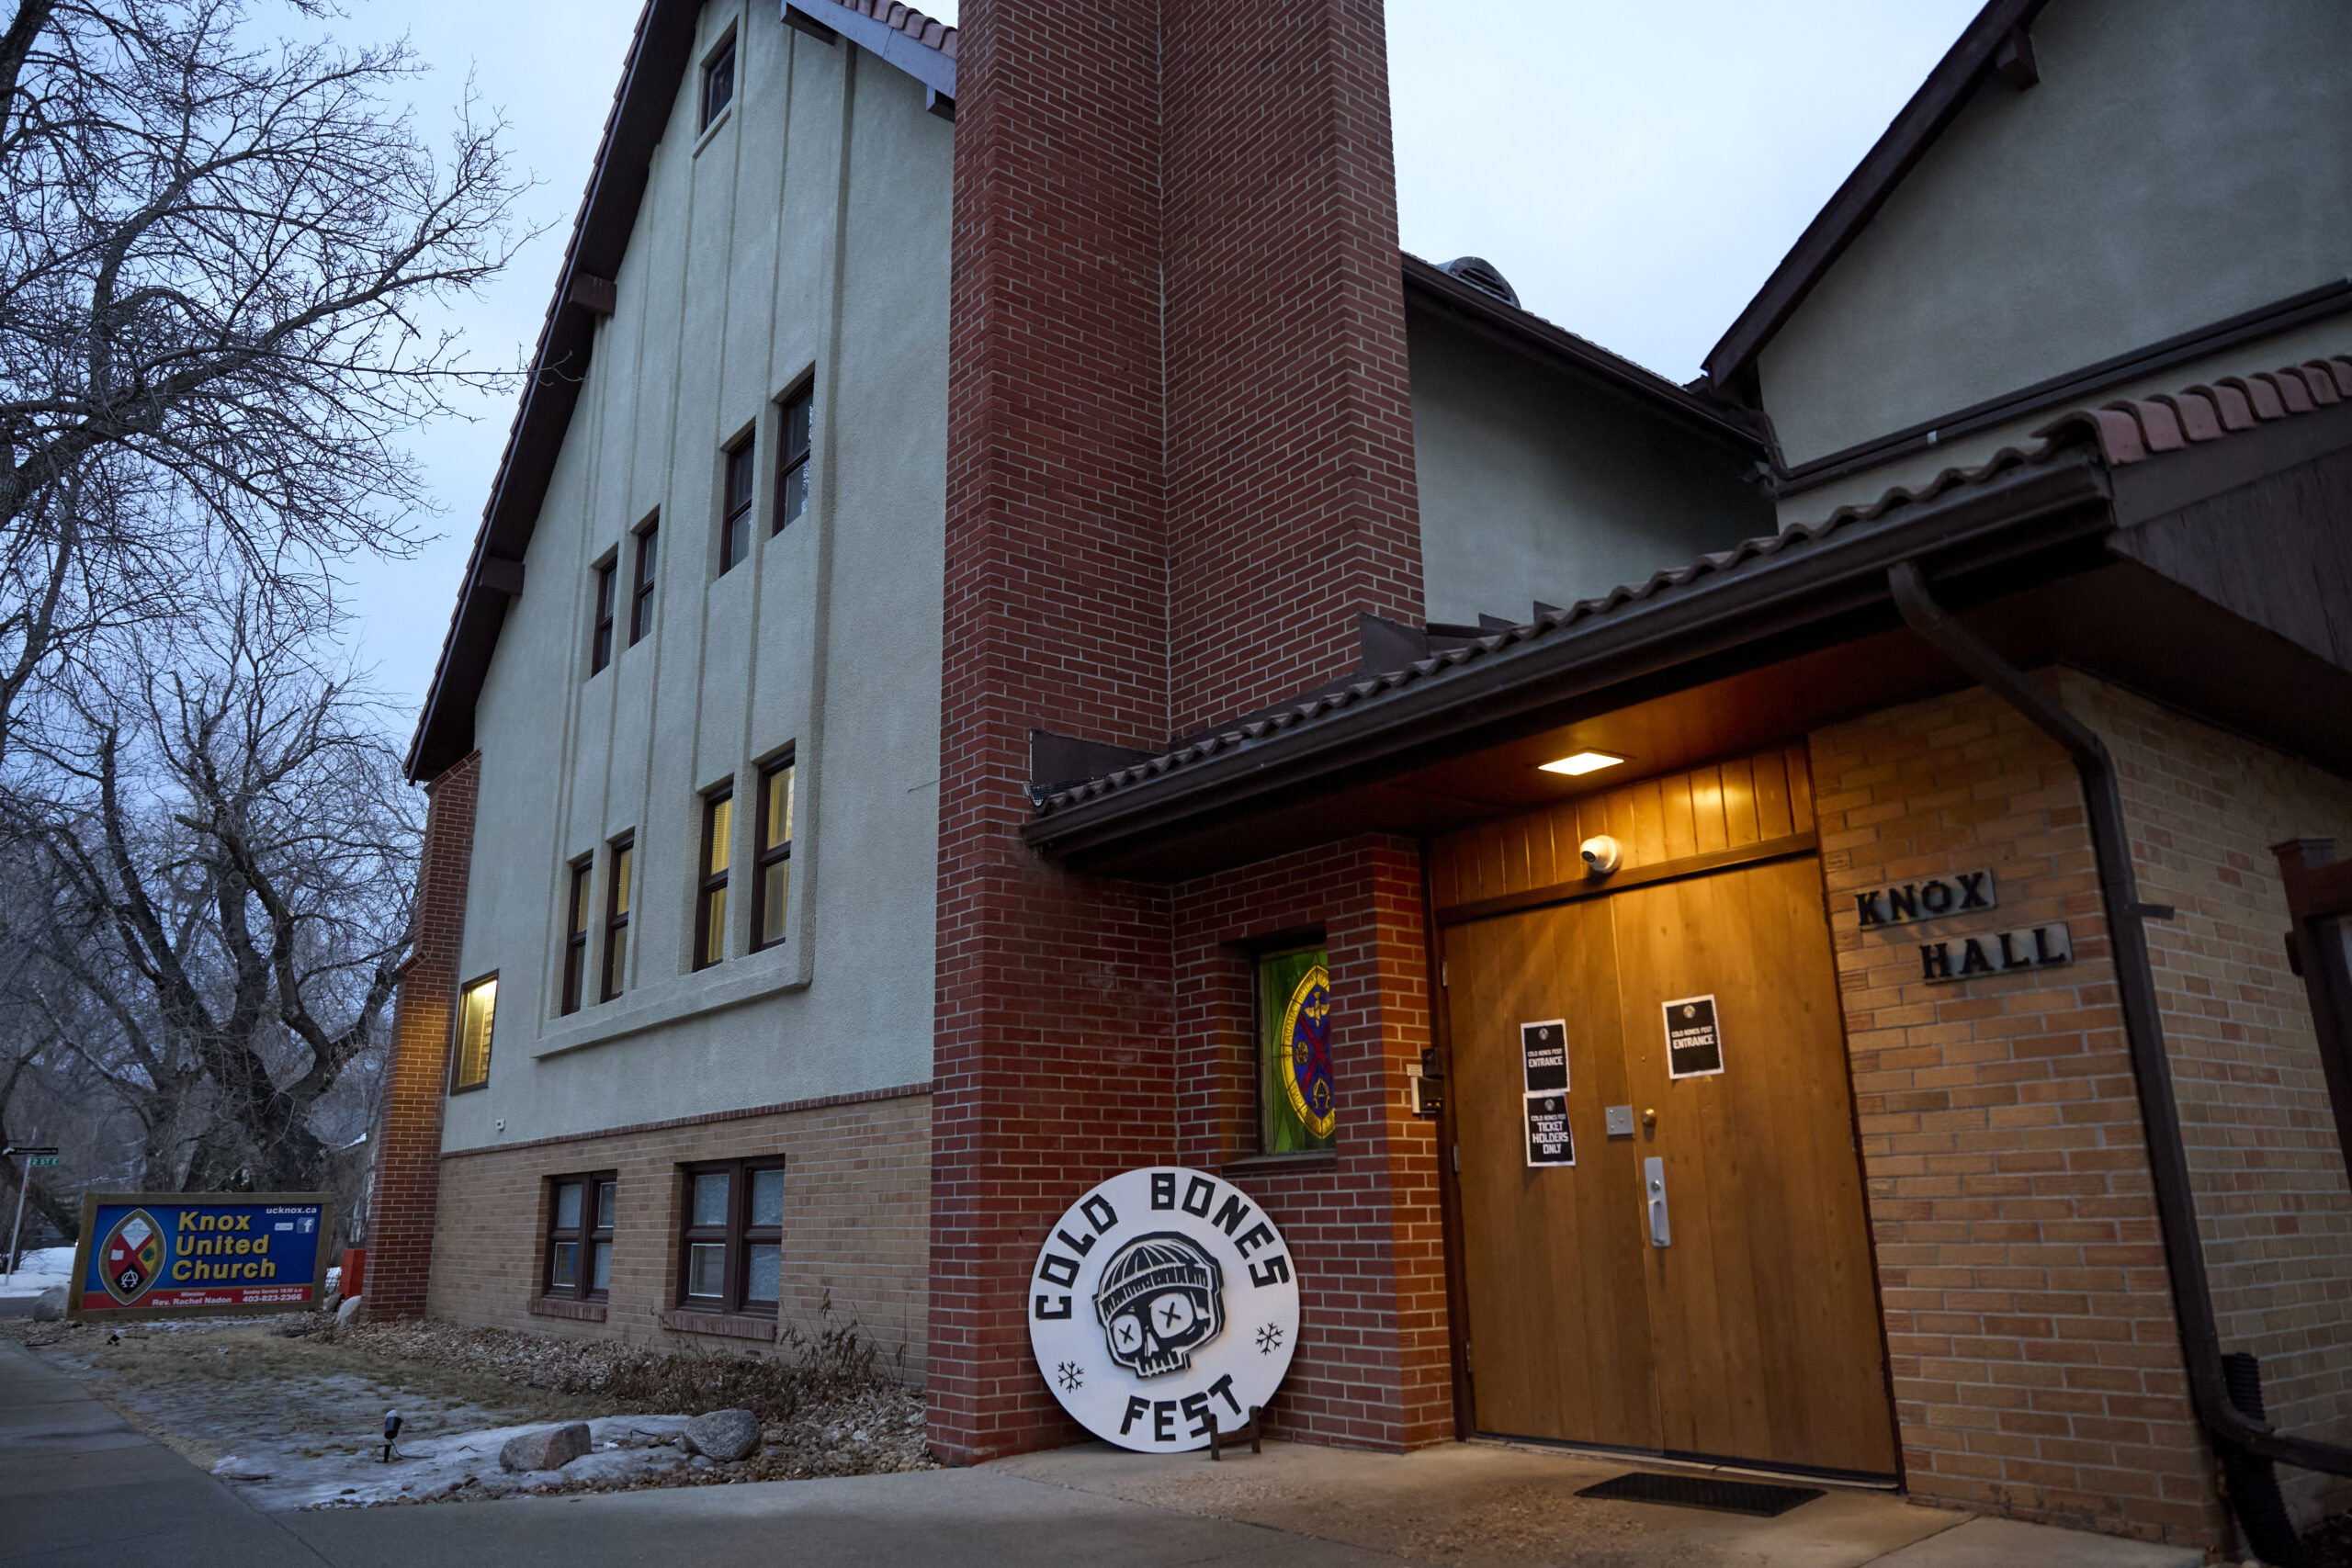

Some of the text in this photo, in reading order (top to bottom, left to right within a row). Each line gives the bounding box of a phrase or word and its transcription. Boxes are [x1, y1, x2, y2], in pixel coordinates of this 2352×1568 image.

[1855, 872, 1989, 926] KNOX
[1919, 928, 2065, 979] HALL
[1672, 1033, 1714, 1050] ENTRANCE
[1528, 1056, 1564, 1068] ENTRANCE
[1536, 1122, 1564, 1133] TICKET
[1532, 1132, 1569, 1144] HOLDERS
[1543, 1144, 1562, 1155] ONLY
[266, 1206, 317, 1214] ucknox.ca
[178, 1211, 252, 1232] Knox
[175, 1234, 270, 1257] United
[1035, 1172, 1290, 1321] COLD BONES
[172, 1258, 276, 1281] Church
[173, 1297, 202, 1305] Rachel
[204, 1296, 232, 1304] Nadon
[243, 1293, 302, 1303] 403-823-2366
[1120, 1373, 1241, 1442] FEST
